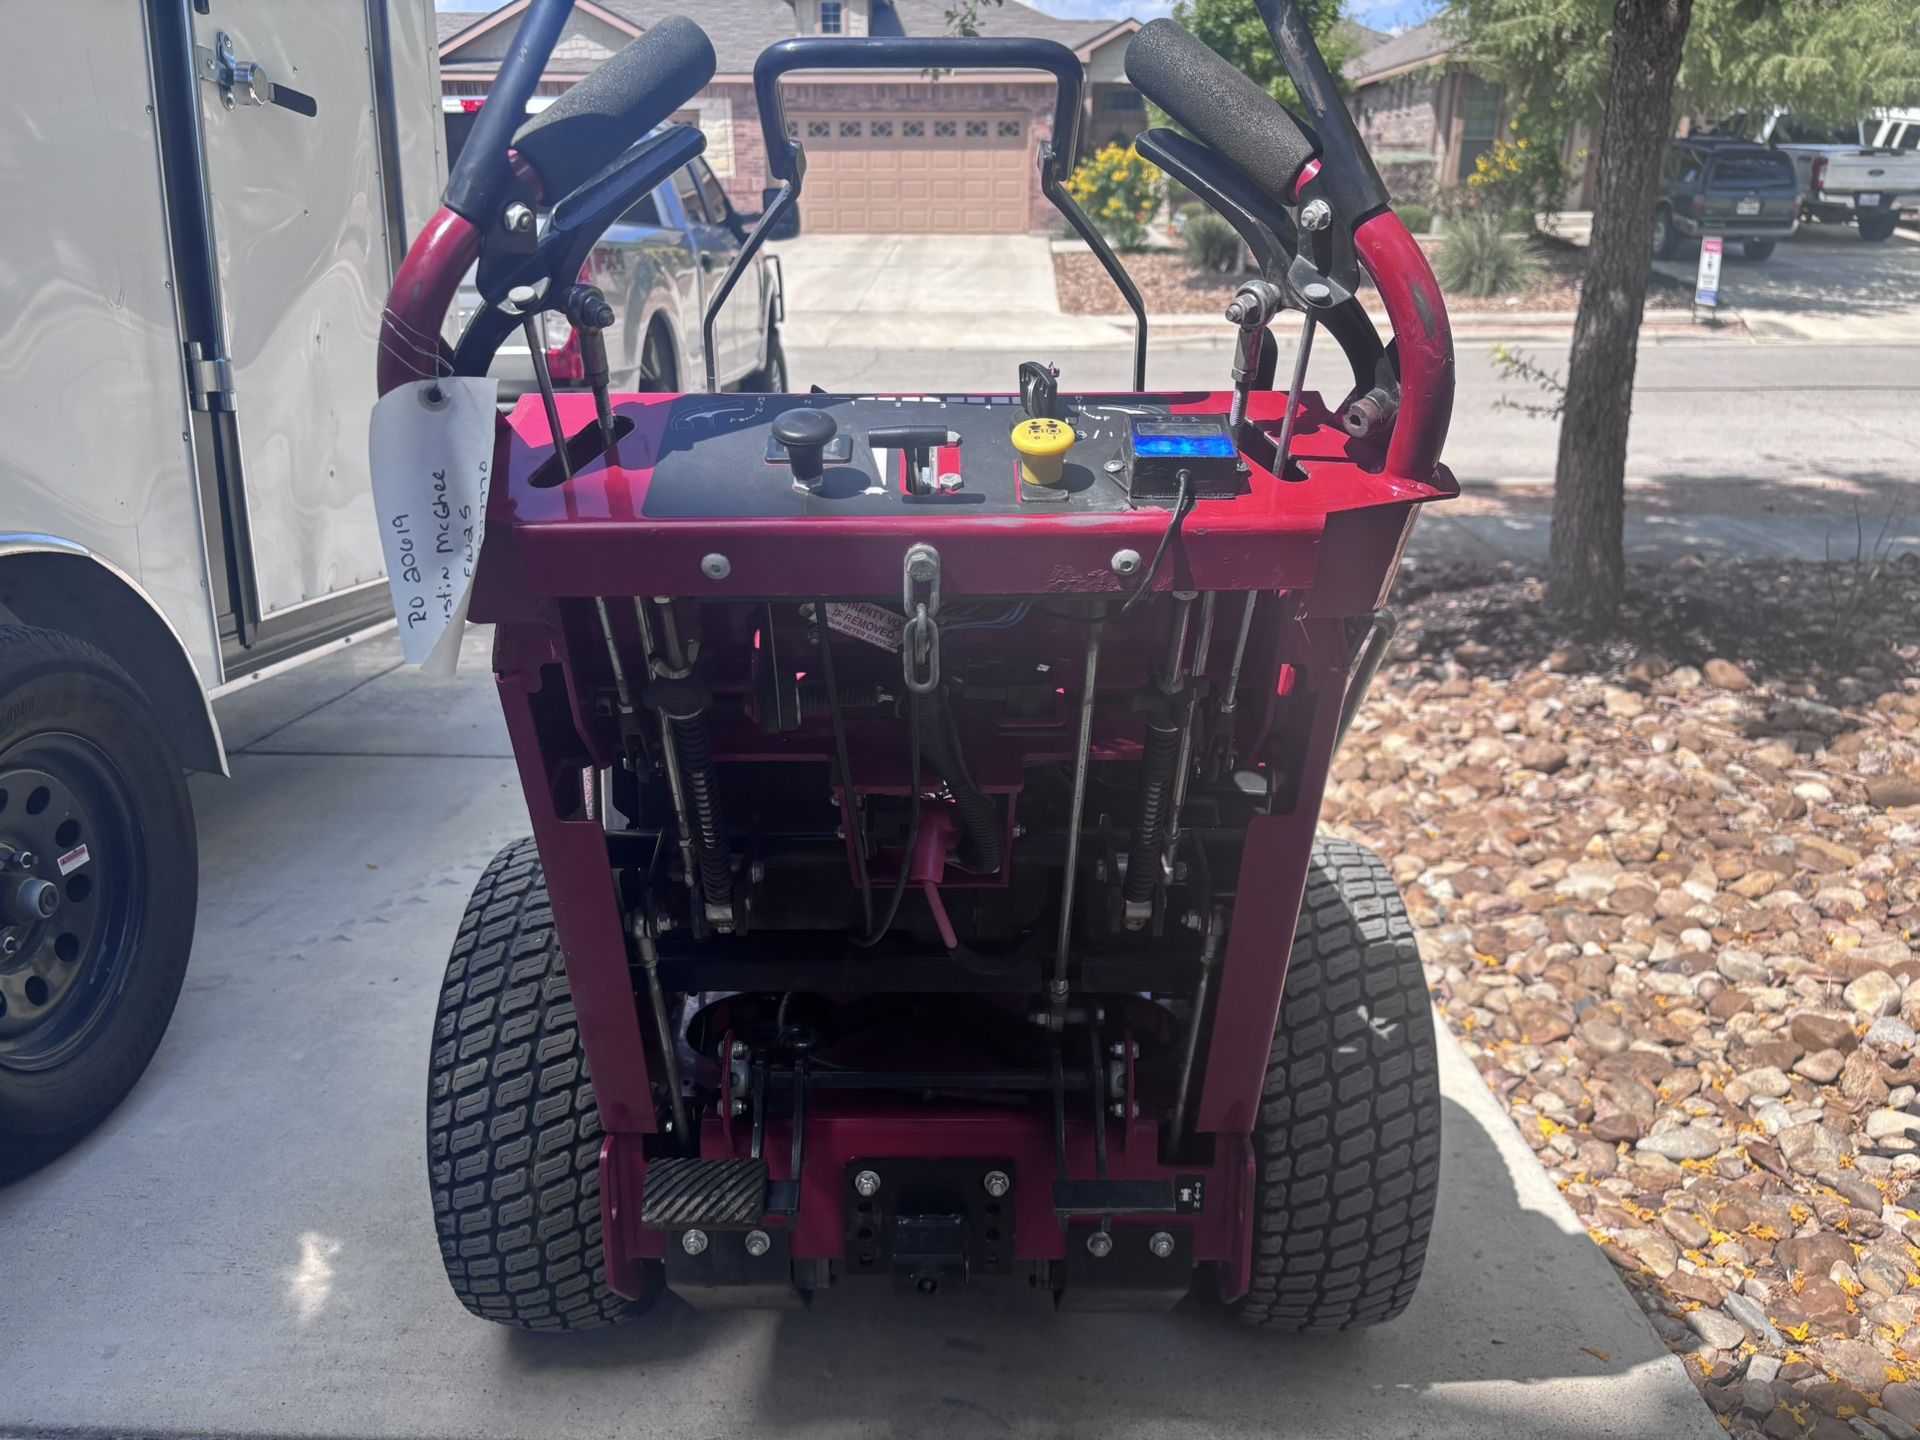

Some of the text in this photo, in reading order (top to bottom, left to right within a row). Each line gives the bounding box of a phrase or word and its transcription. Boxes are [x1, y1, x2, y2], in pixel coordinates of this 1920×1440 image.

[392, 513, 422, 584] 20619
[432, 468, 454, 624] stin McGhee
[832, 609, 895, 639] IF REMOVED
[843, 623, 866, 636] METER
